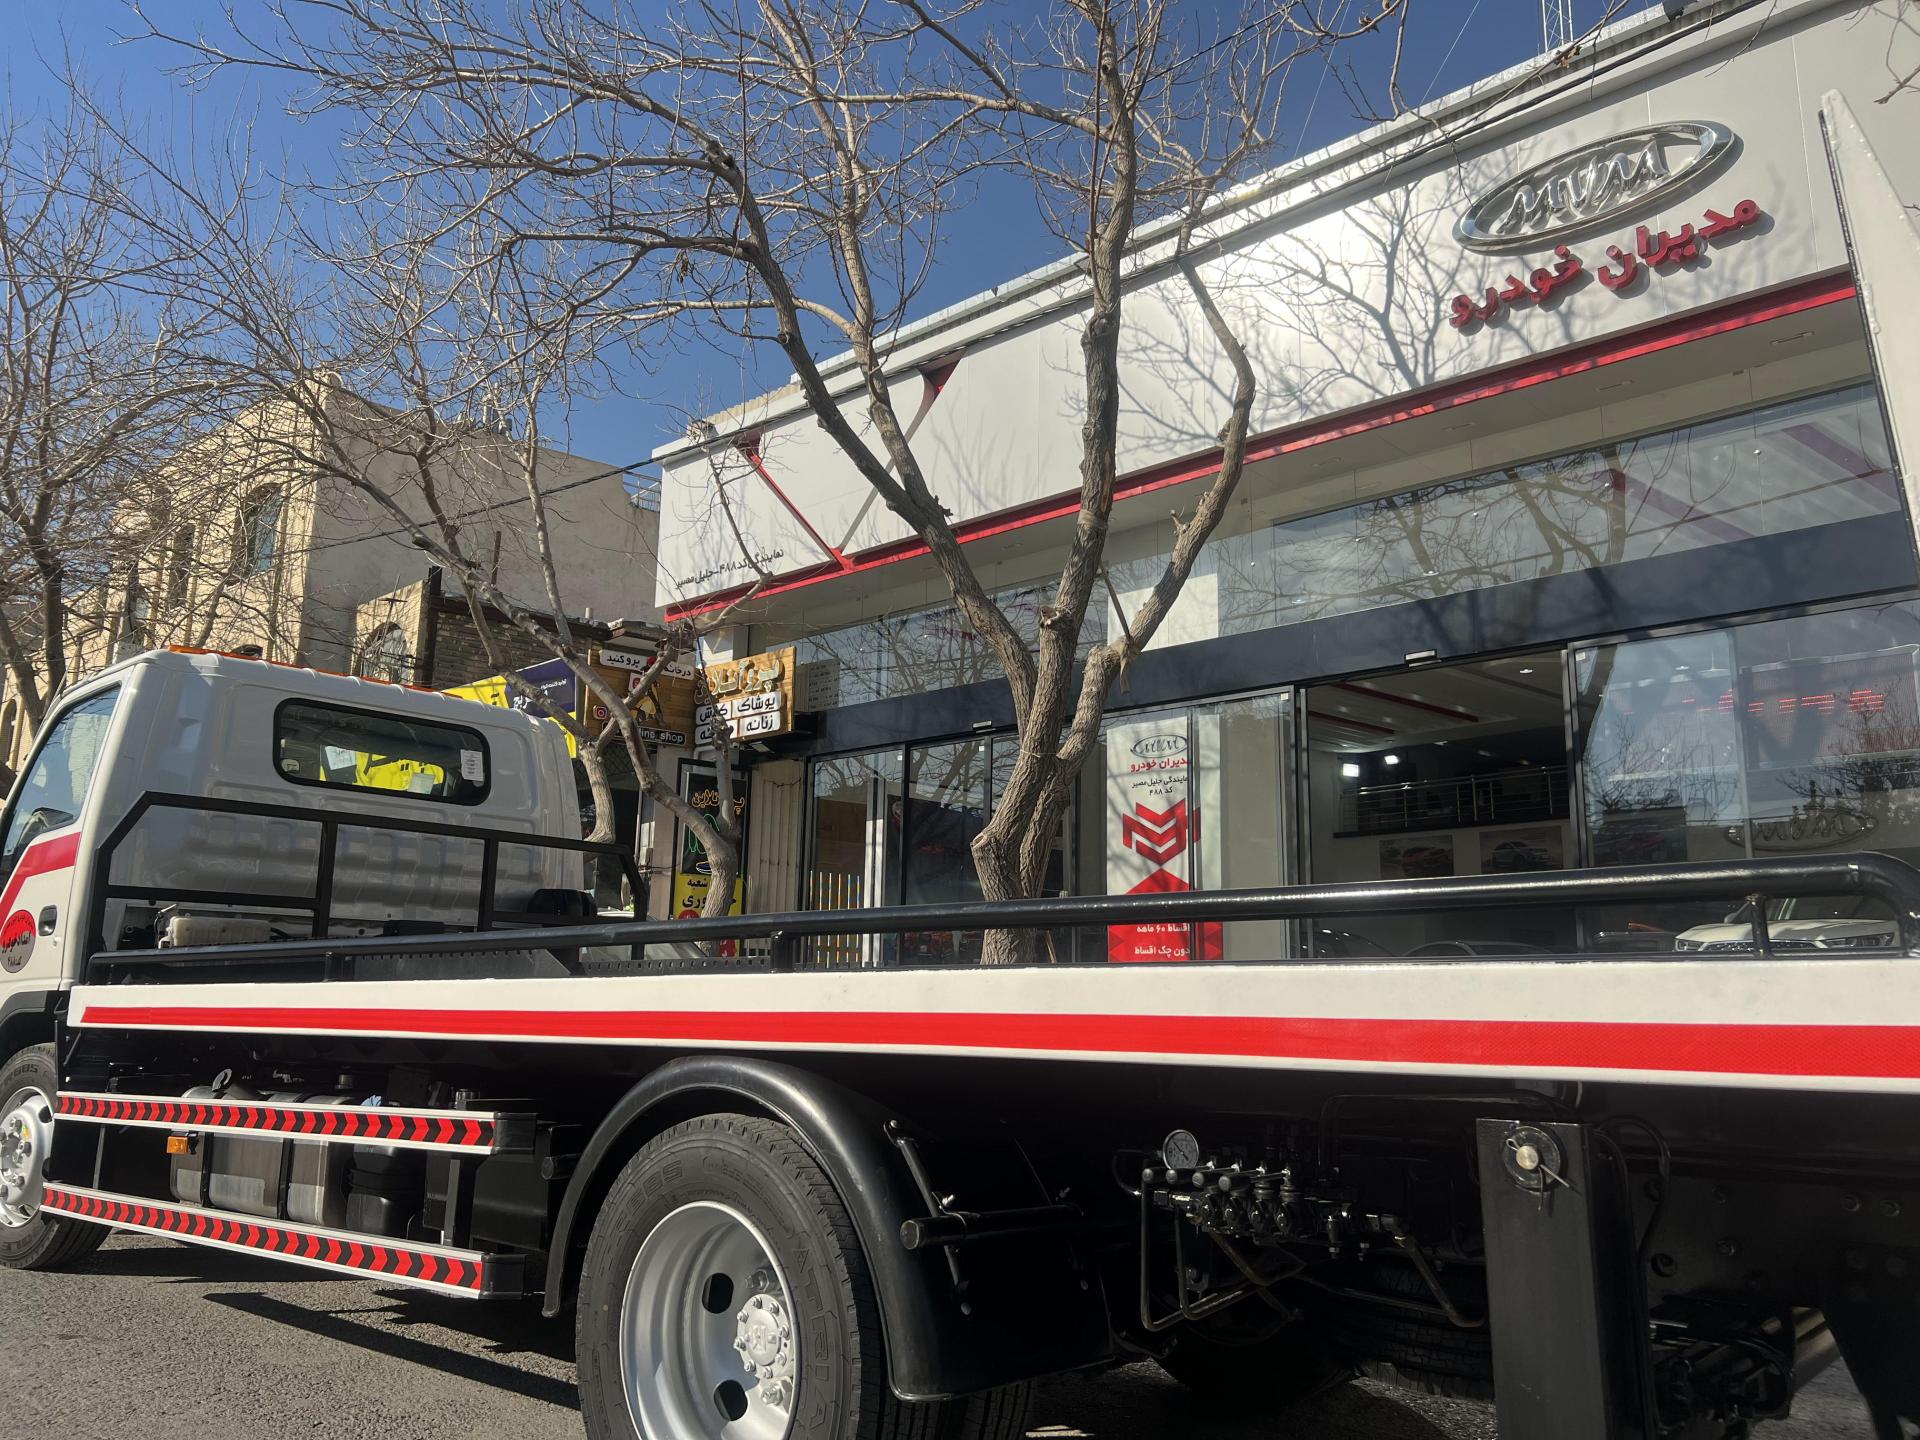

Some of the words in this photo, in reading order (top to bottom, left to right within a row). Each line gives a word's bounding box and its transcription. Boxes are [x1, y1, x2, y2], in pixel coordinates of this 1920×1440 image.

[1597, 199, 1761, 290] مدیران
[1449, 244, 1583, 328] خودرو
[737, 695, 776, 712] پوشاک
[746, 714, 774, 732] زنانه
[1130, 759, 1157, 773] خودرو
[1164, 785, 1173, 794] کد
[1167, 922, 1190, 932] اقساط
[1134, 945, 1157, 955] اقساط
[1157, 945, 1172, 959] چک
[1173, 947, 1190, 957] دون
